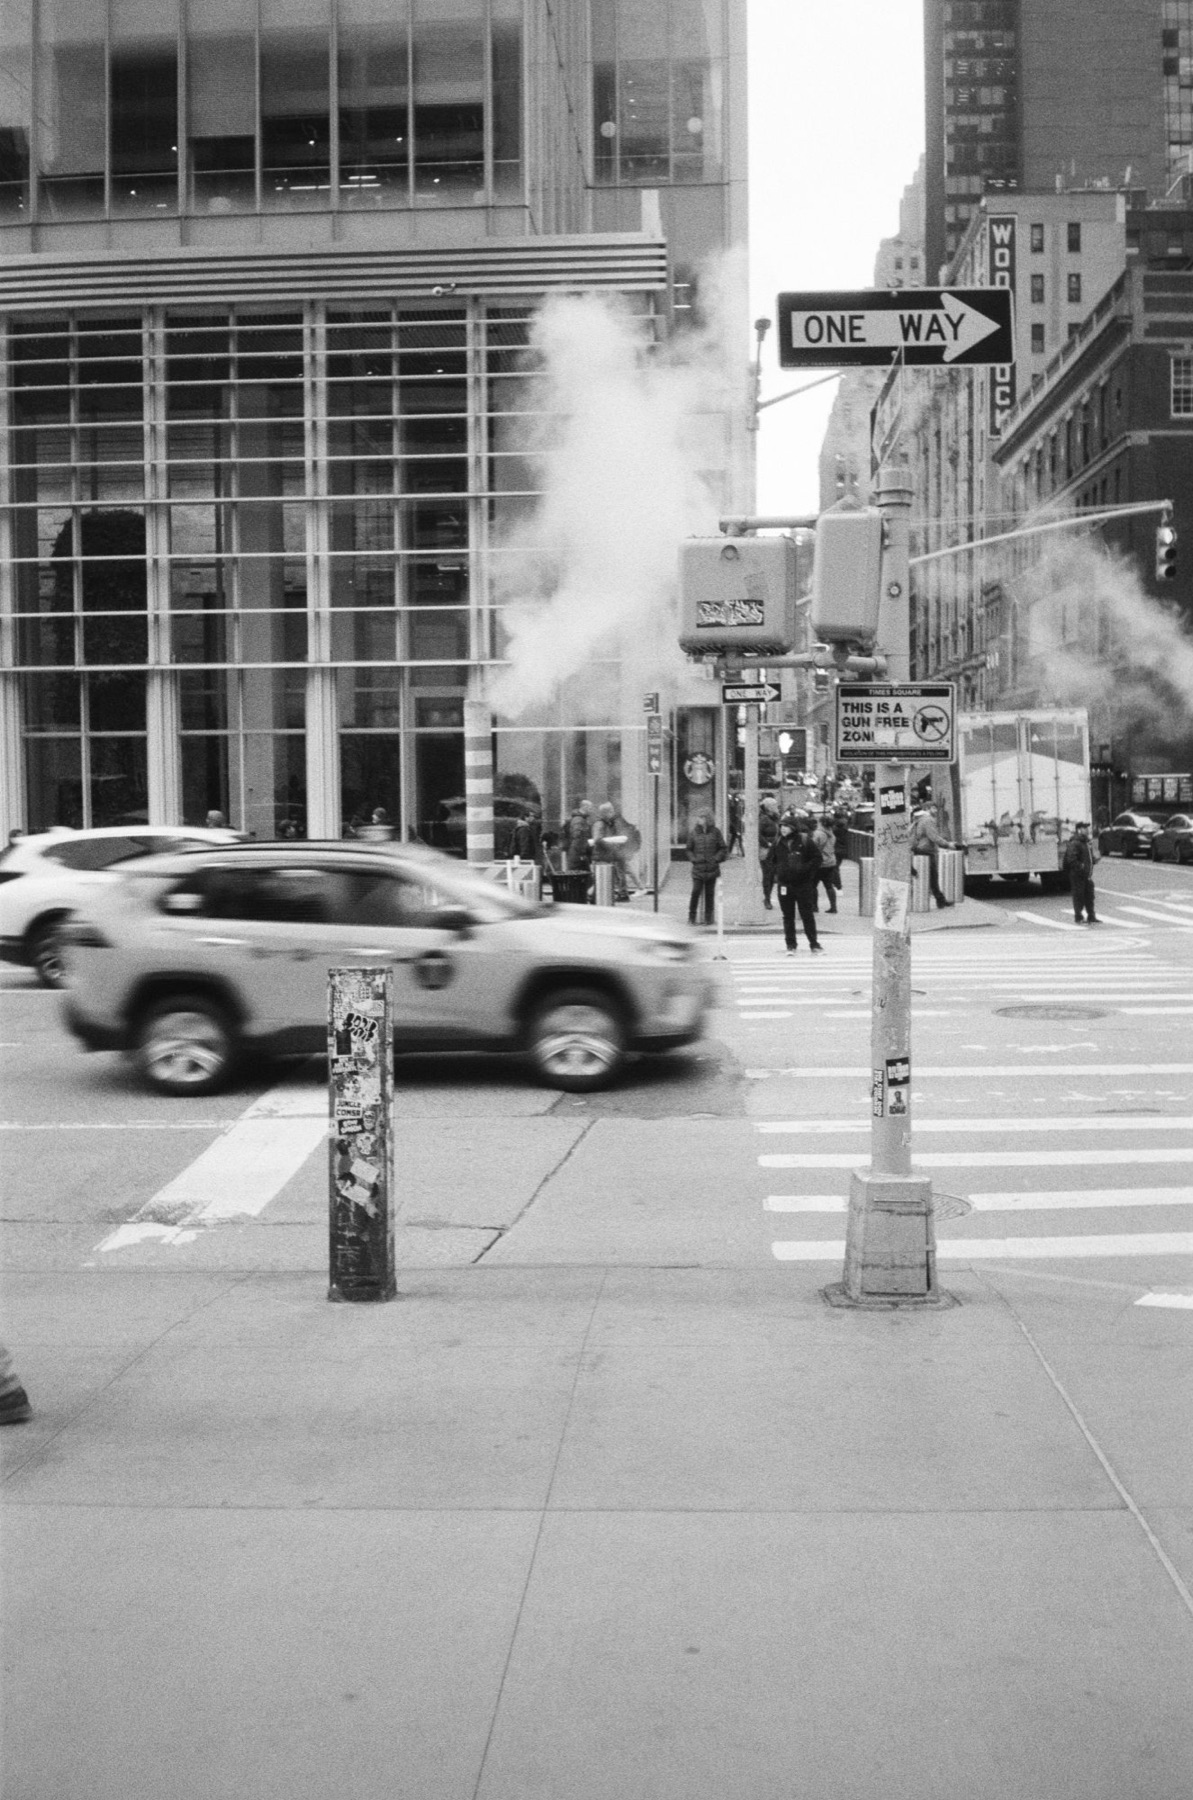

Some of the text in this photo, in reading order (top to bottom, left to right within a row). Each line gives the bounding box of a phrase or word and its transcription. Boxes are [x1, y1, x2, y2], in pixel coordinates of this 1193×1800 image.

[804, 313, 966, 343] ONE WAY
[992, 224, 1012, 428] WOOOCK
[730, 690, 747, 698] ONE
[842, 703, 903, 713] THIS IS A
[842, 717, 909, 727] GUN FREE
[842, 731, 875, 742] ZON
